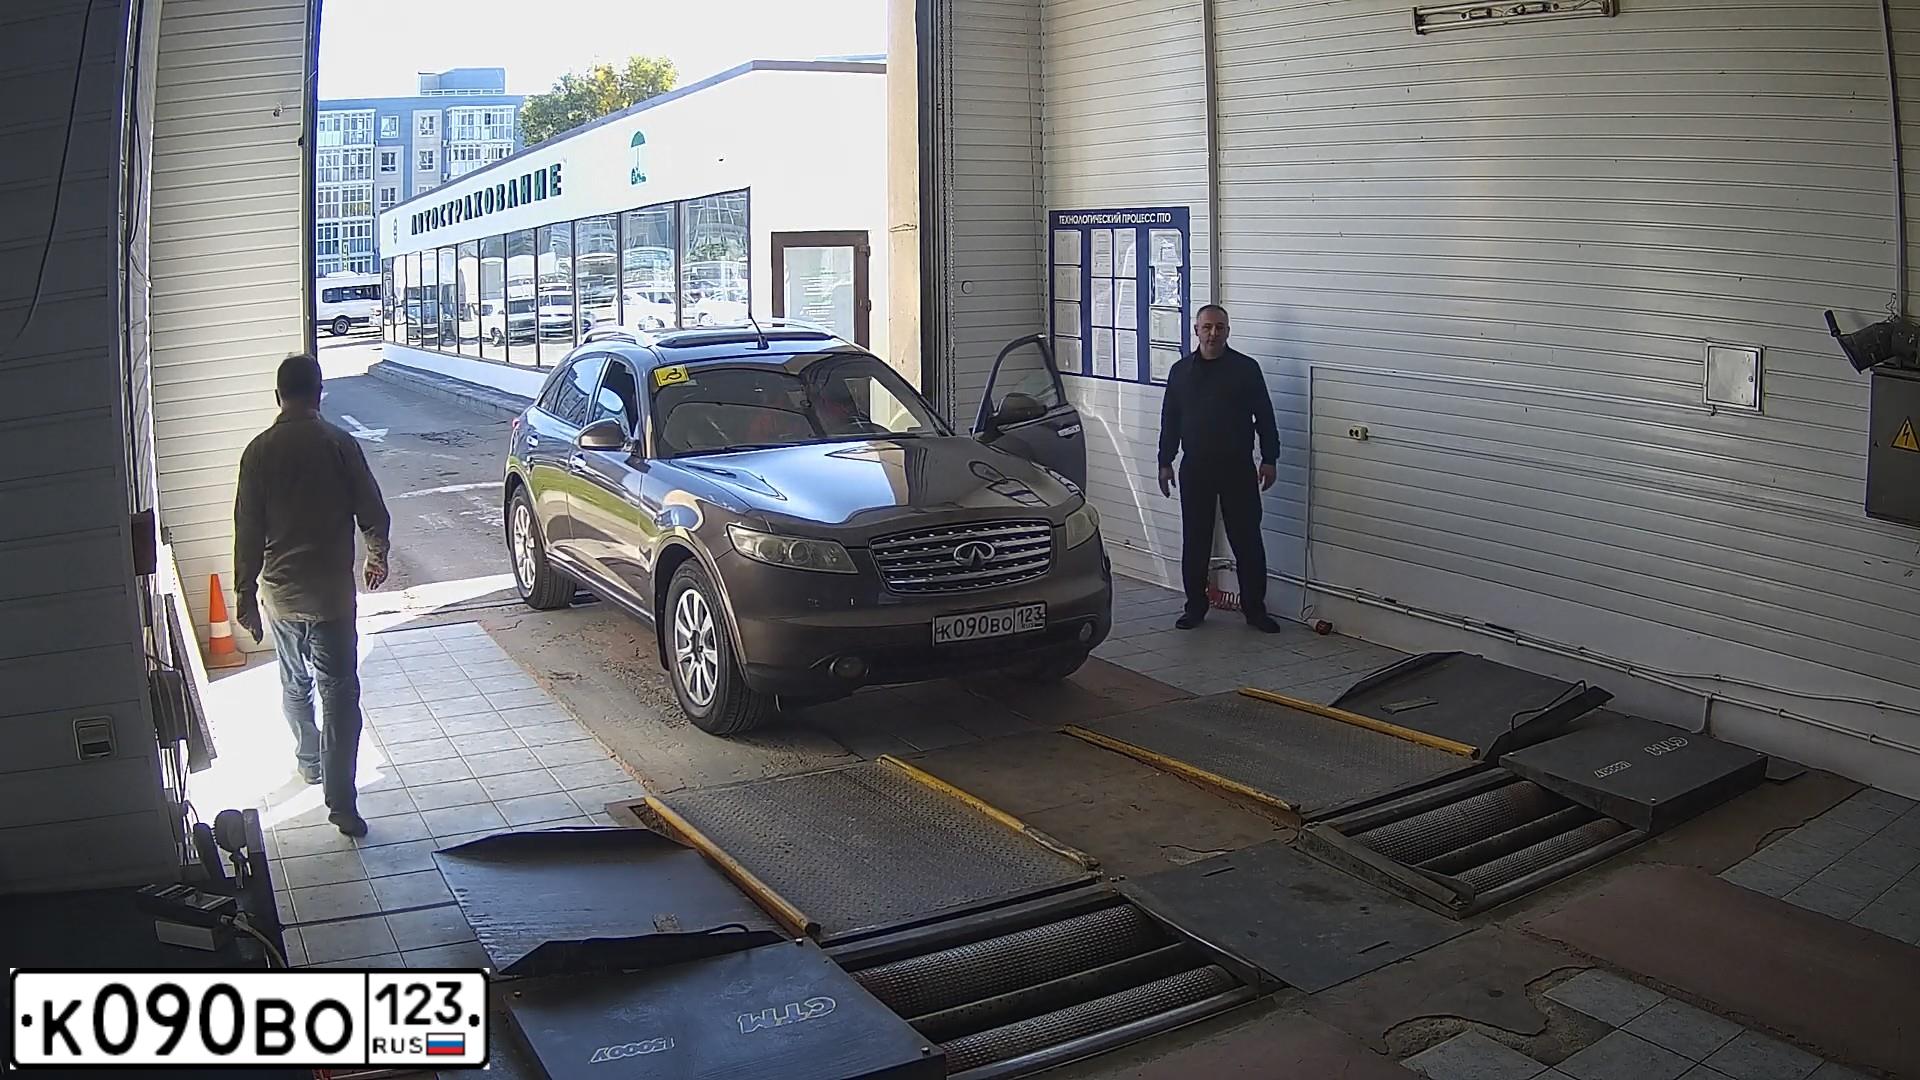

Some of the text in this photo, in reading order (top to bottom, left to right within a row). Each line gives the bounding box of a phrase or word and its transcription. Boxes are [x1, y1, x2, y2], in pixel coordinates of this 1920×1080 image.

[411, 164, 562, 236] АВТОСТРАХОВАНИЕ
[1059, 212, 1121, 224] ТЕХНОЛОГИЧЕСКИЙ
[1122, 213, 1156, 224] ПРОЦЕСС
[940, 606, 1042, 640] К090ВО 123
